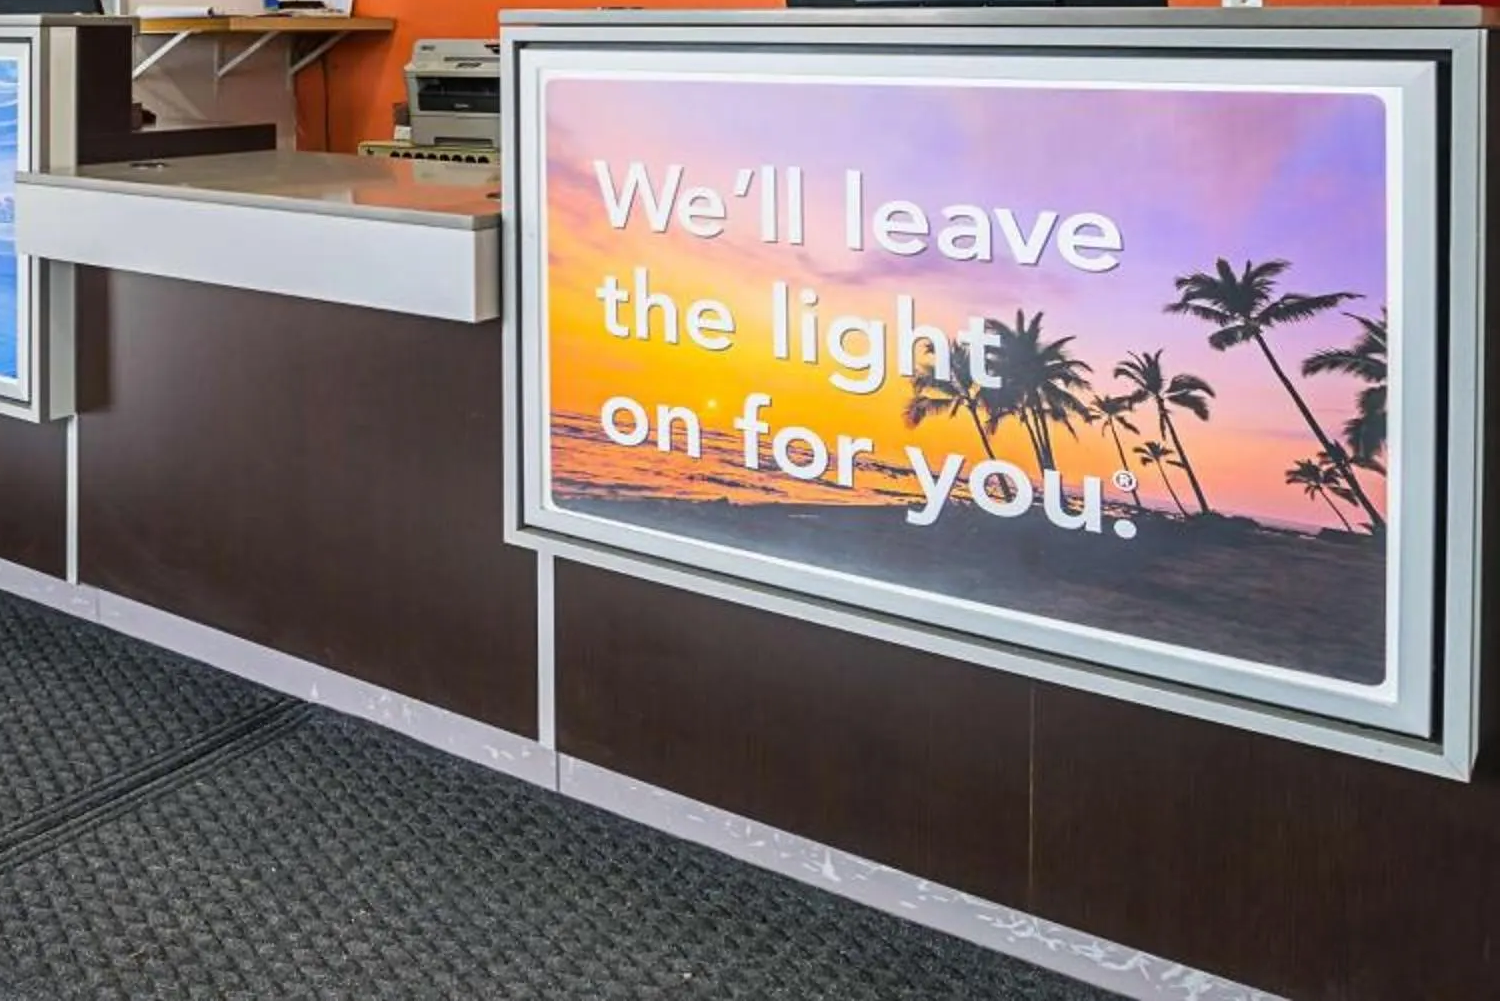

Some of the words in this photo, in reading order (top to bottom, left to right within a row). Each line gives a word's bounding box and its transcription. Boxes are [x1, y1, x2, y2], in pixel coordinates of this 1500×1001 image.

[594, 159, 803, 246] We'll
[846, 169, 1125, 273] leave
[596, 267, 737, 351] the
[772, 282, 1002, 394] light
[600, 395, 703, 459] on
[733, 392, 875, 488] for
